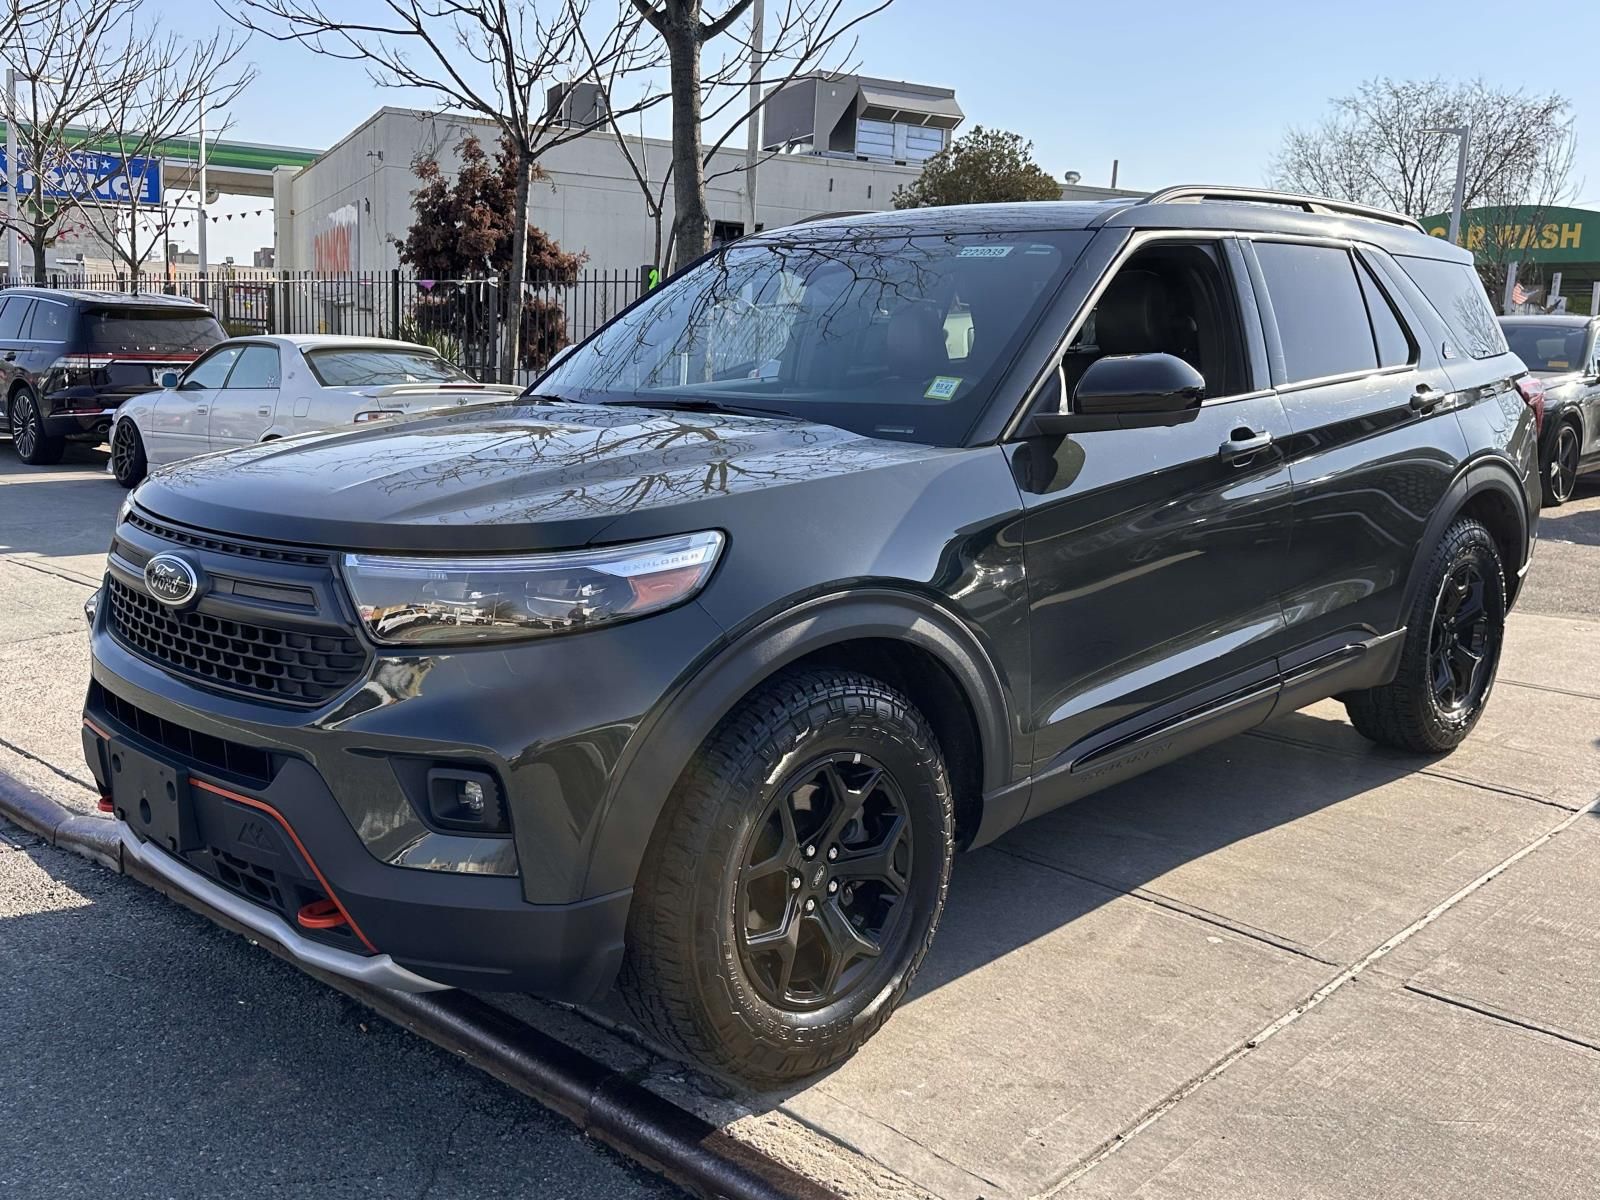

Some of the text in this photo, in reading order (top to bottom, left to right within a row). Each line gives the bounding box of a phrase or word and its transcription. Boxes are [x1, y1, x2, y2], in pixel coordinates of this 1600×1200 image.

[1494, 223, 1582, 249] WASH
[623, 552, 699, 570] EXPLORER
[151, 563, 180, 594] Ford
